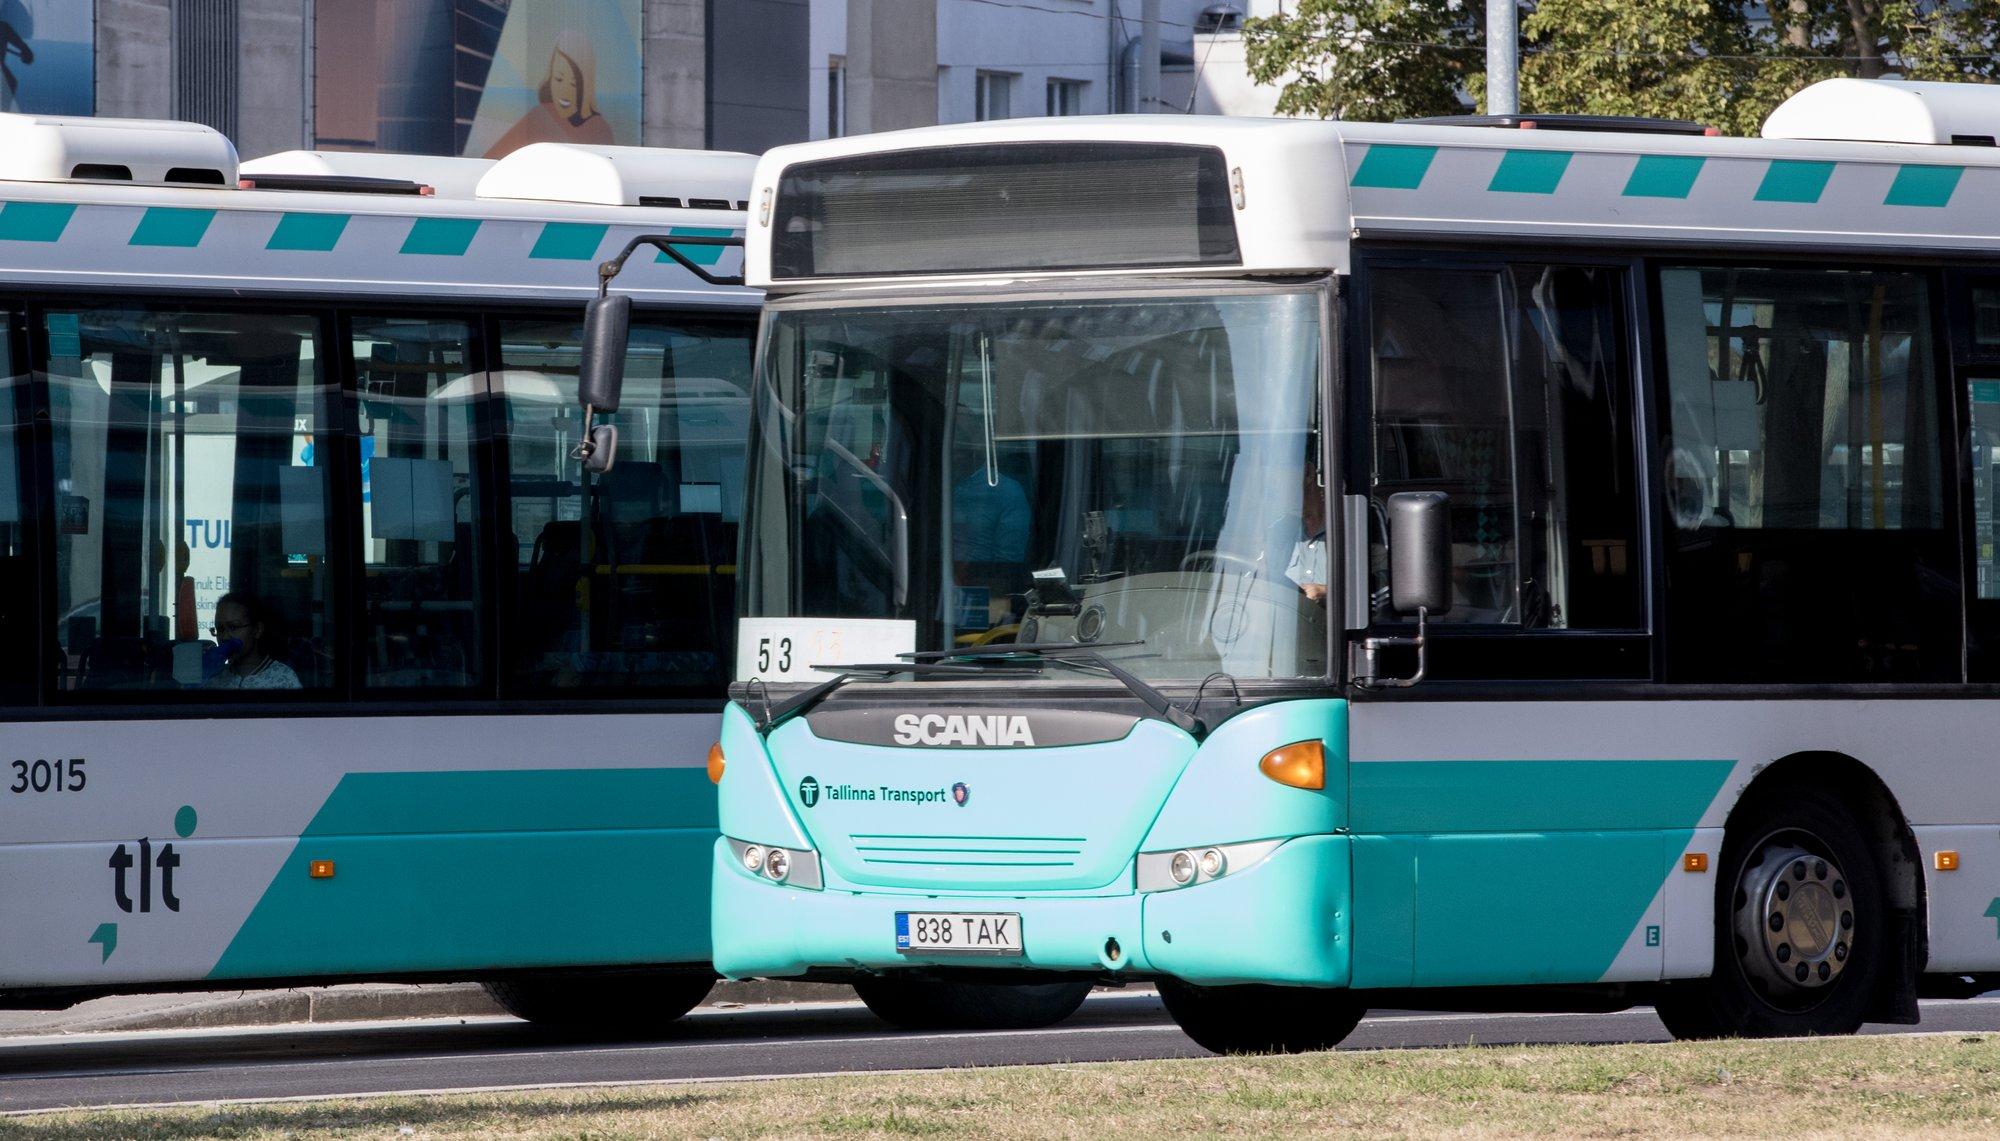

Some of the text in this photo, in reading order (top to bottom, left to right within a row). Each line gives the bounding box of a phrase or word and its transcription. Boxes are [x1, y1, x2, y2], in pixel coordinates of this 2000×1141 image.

[893, 713, 1035, 746] SCANIA
[10, 758, 86, 793] 3015
[825, 784, 946, 805] Tallinna Transport
[108, 836, 181, 913] tlt
[917, 917, 1010, 945] 838 TAK
[1648, 928, 1657, 944] E
